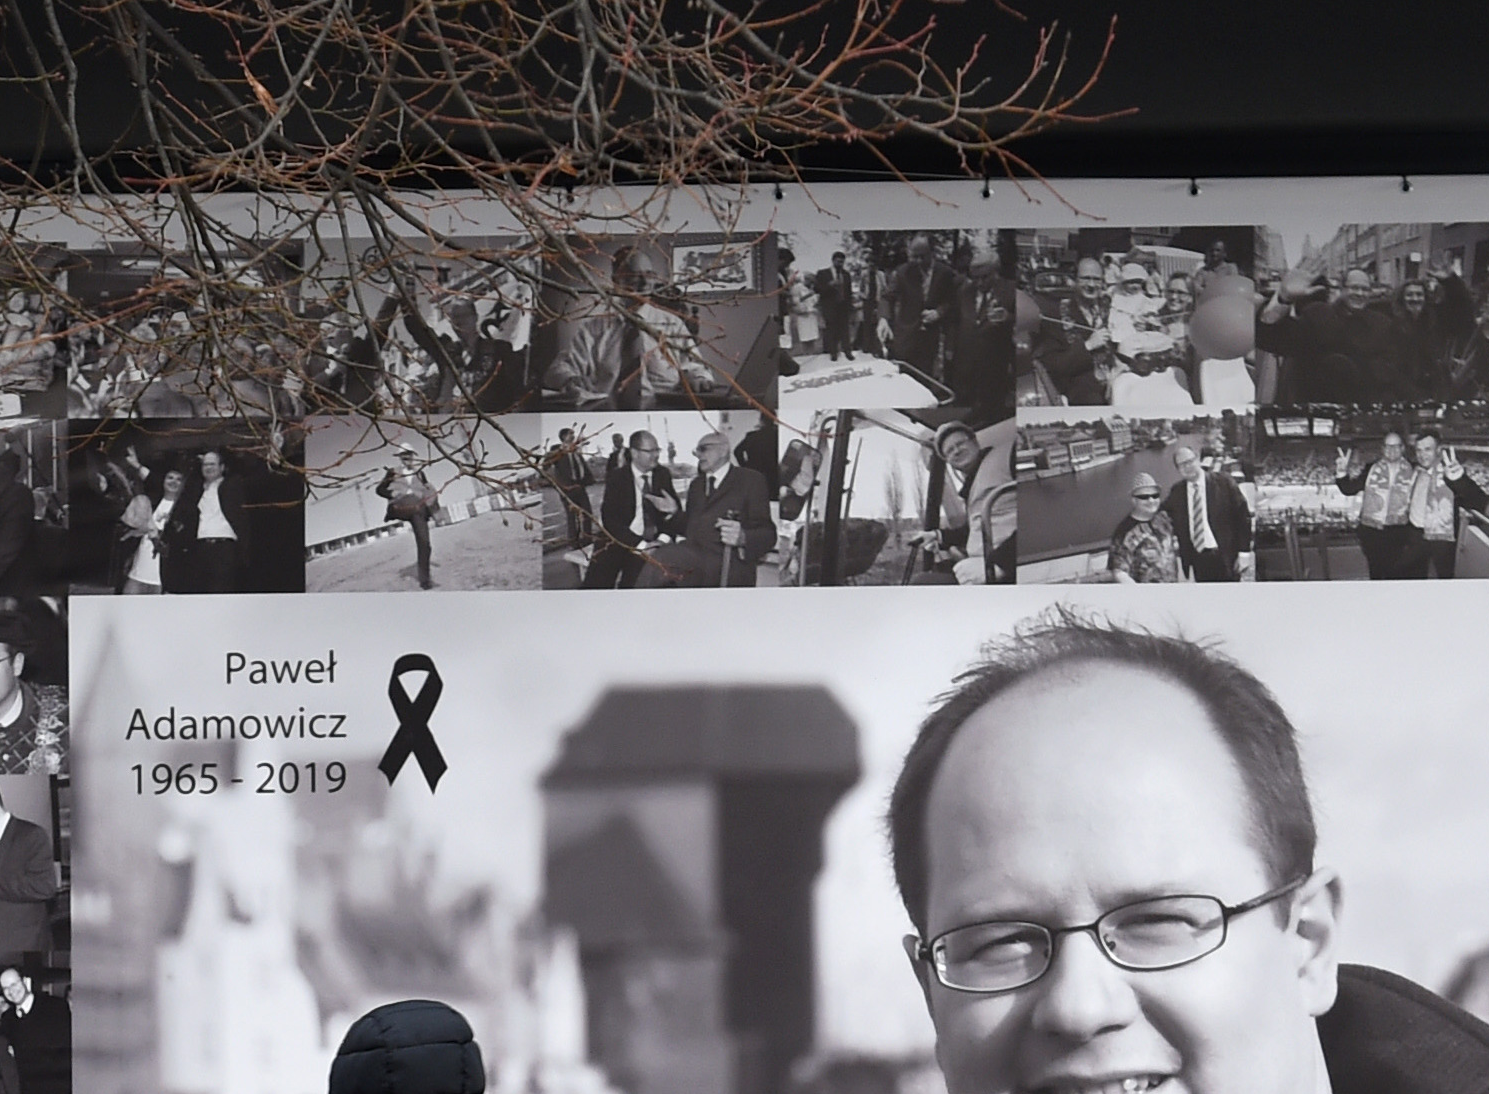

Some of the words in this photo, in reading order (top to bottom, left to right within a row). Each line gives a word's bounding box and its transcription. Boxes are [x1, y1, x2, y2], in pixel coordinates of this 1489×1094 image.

[225, 649, 338, 685] Paweł
[125, 706, 348, 741] Adamowicz
[130, 762, 219, 795] 1965
[255, 760, 347, 794] 2019
